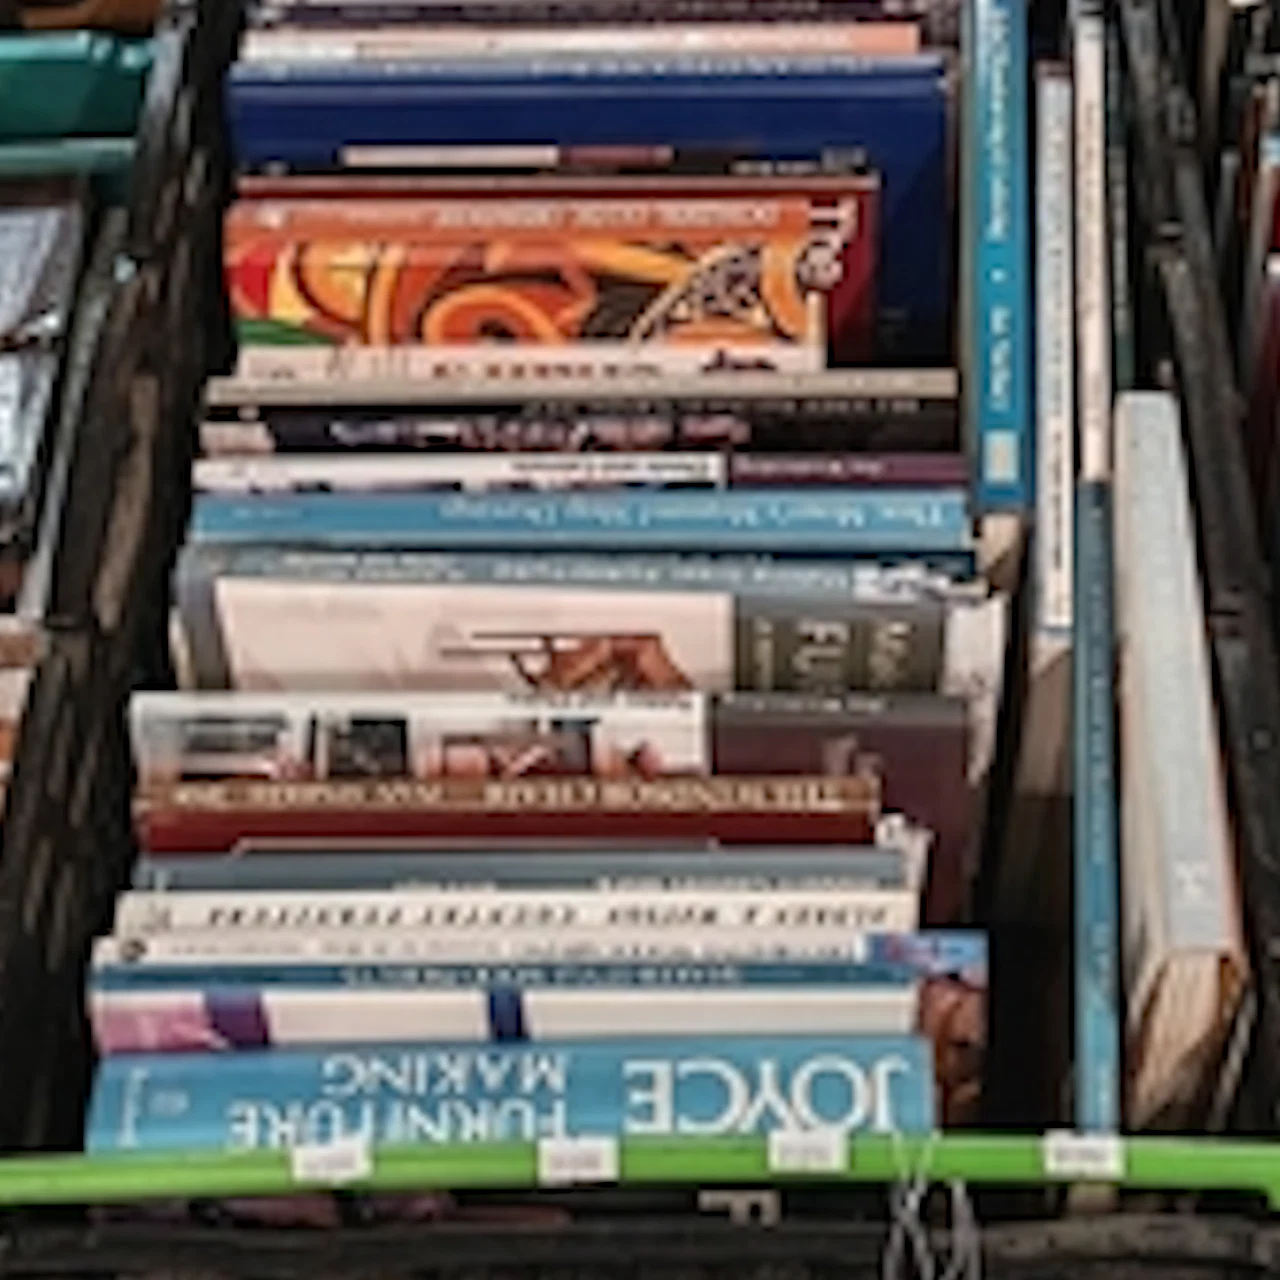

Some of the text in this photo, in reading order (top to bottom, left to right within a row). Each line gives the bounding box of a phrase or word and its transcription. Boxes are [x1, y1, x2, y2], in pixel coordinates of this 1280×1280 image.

[318, 1052, 566, 1098] MAKING
[620, 1054, 911, 1136] JOYCE
[224, 1097, 566, 1149] FURNITURE
